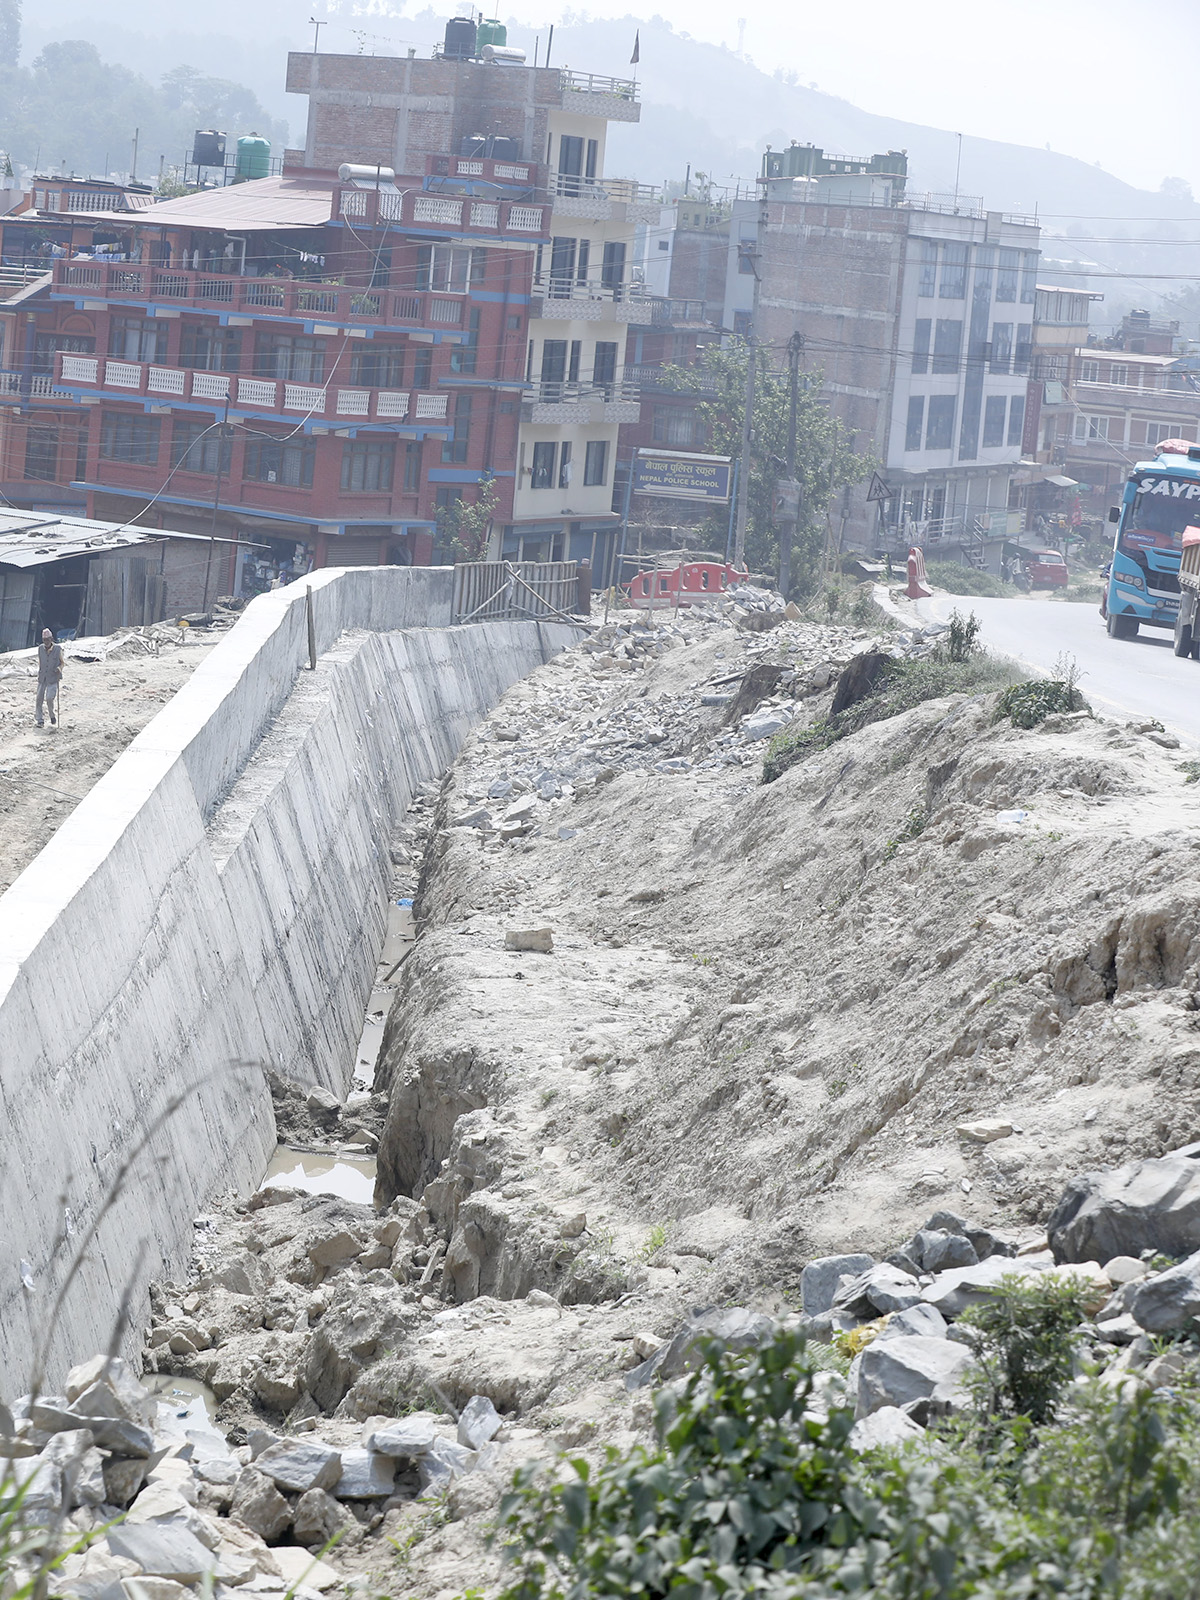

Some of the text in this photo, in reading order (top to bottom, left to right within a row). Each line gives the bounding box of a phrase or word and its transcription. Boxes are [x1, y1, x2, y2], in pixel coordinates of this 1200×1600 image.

[645, 460, 668, 472] नेपाल
[670, 462, 693, 474] पुलिस
[695, 466, 716, 476] स्कूल
[639, 475, 662, 483] NEPAL
[663, 477, 689, 485] POLICE
[690, 479, 719, 488] SCHOOL
[1136, 478, 1200, 501] SAYP
